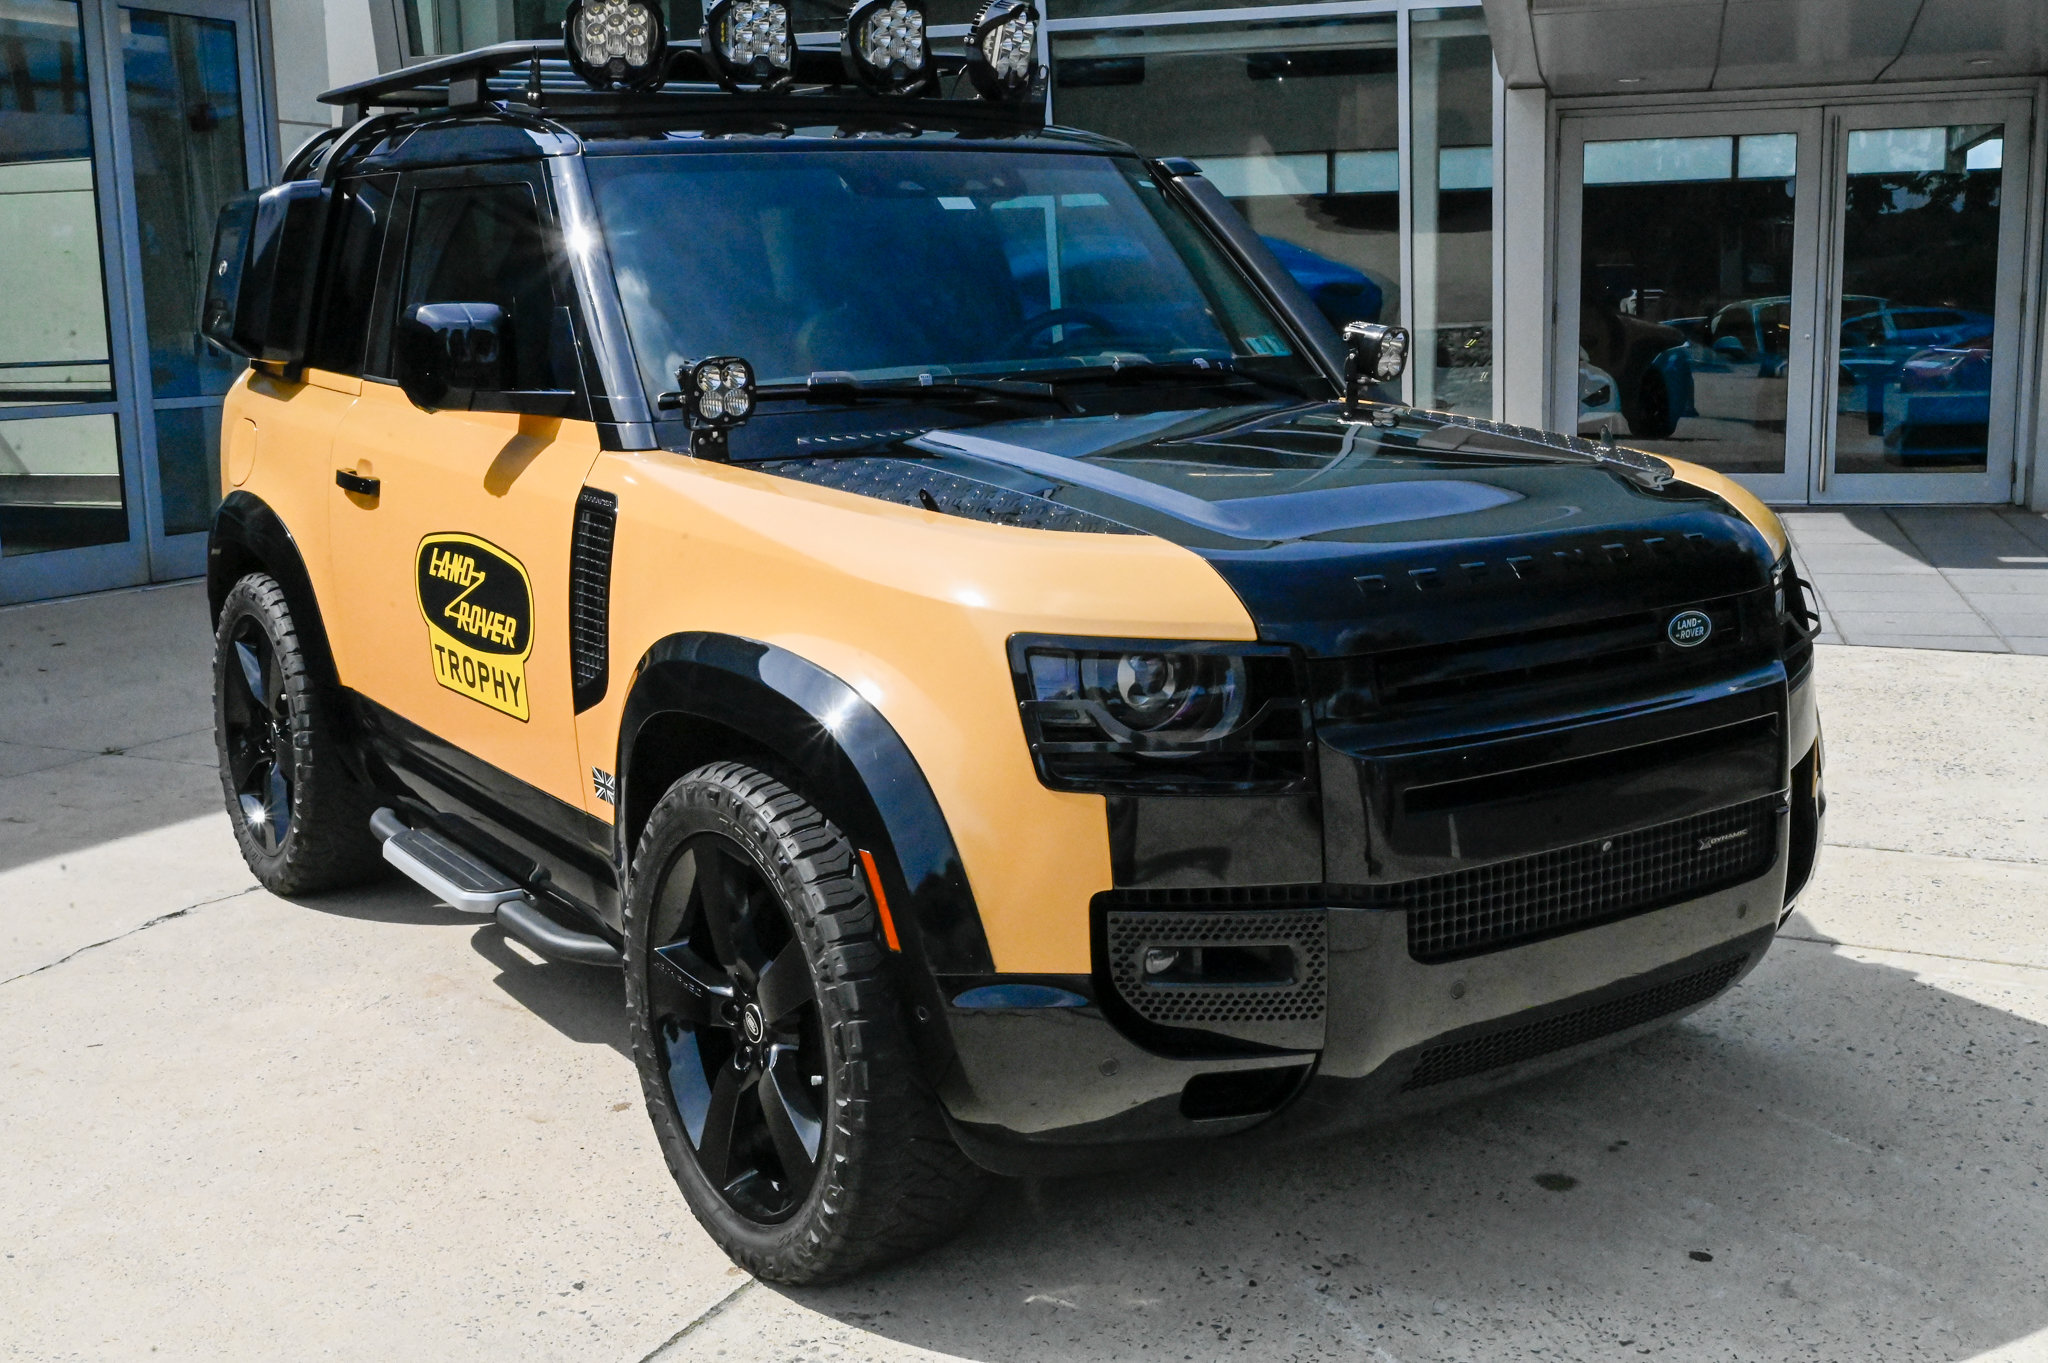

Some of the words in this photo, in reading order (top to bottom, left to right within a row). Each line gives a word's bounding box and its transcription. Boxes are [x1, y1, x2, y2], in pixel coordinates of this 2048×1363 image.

[428, 547, 475, 587] LAND
[456, 600, 517, 649] ROVER
[434, 643, 521, 708] TROPHY
